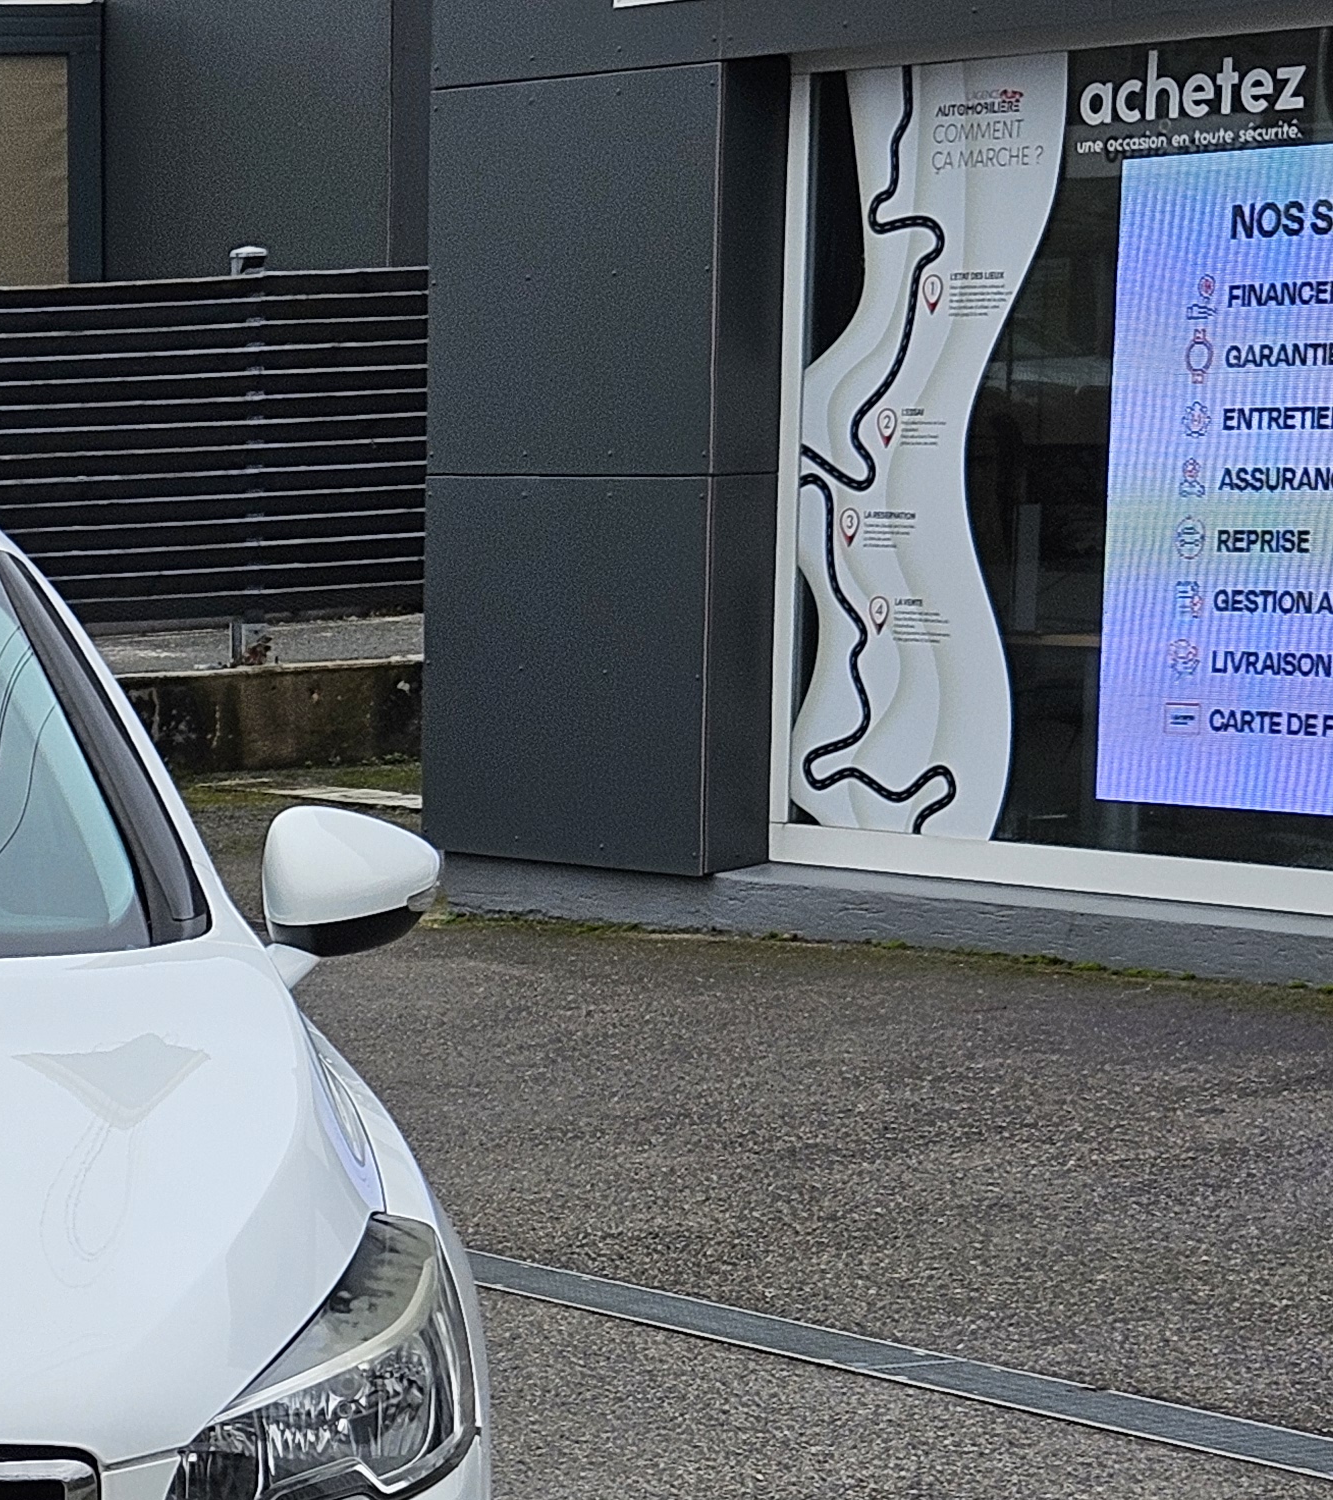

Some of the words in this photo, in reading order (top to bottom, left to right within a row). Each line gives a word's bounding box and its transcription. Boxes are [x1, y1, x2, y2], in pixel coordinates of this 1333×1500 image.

[1080, 50, 1307, 126] achetez
[933, 119, 1025, 144] COMMENT
[1077, 139, 1104, 154] une
[1107, 131, 1167, 152] occasion
[1172, 133, 1189, 148] en
[1194, 129, 1233, 145] toute
[931, 151, 954, 175] ÇA
[957, 146, 1030, 169] MARCHE
[1035, 145, 1044, 165] ?
[1231, 201, 1305, 239] NOS
[1228, 280, 1333, 308] FINANCE
[884, 415, 891, 429] 2
[1223, 407, 1333, 431] ENTRETIE
[1218, 467, 1333, 491] ASSURAN
[845, 515, 854, 530] 3
[1217, 530, 1311, 553] REPRISE
[874, 603, 883, 618] 4
[1214, 589, 1313, 614] GESTION
[1211, 650, 1332, 678] LIVRAISON
[1209, 709, 1282, 734] CARTE
[1287, 712, 1318, 736] DE
